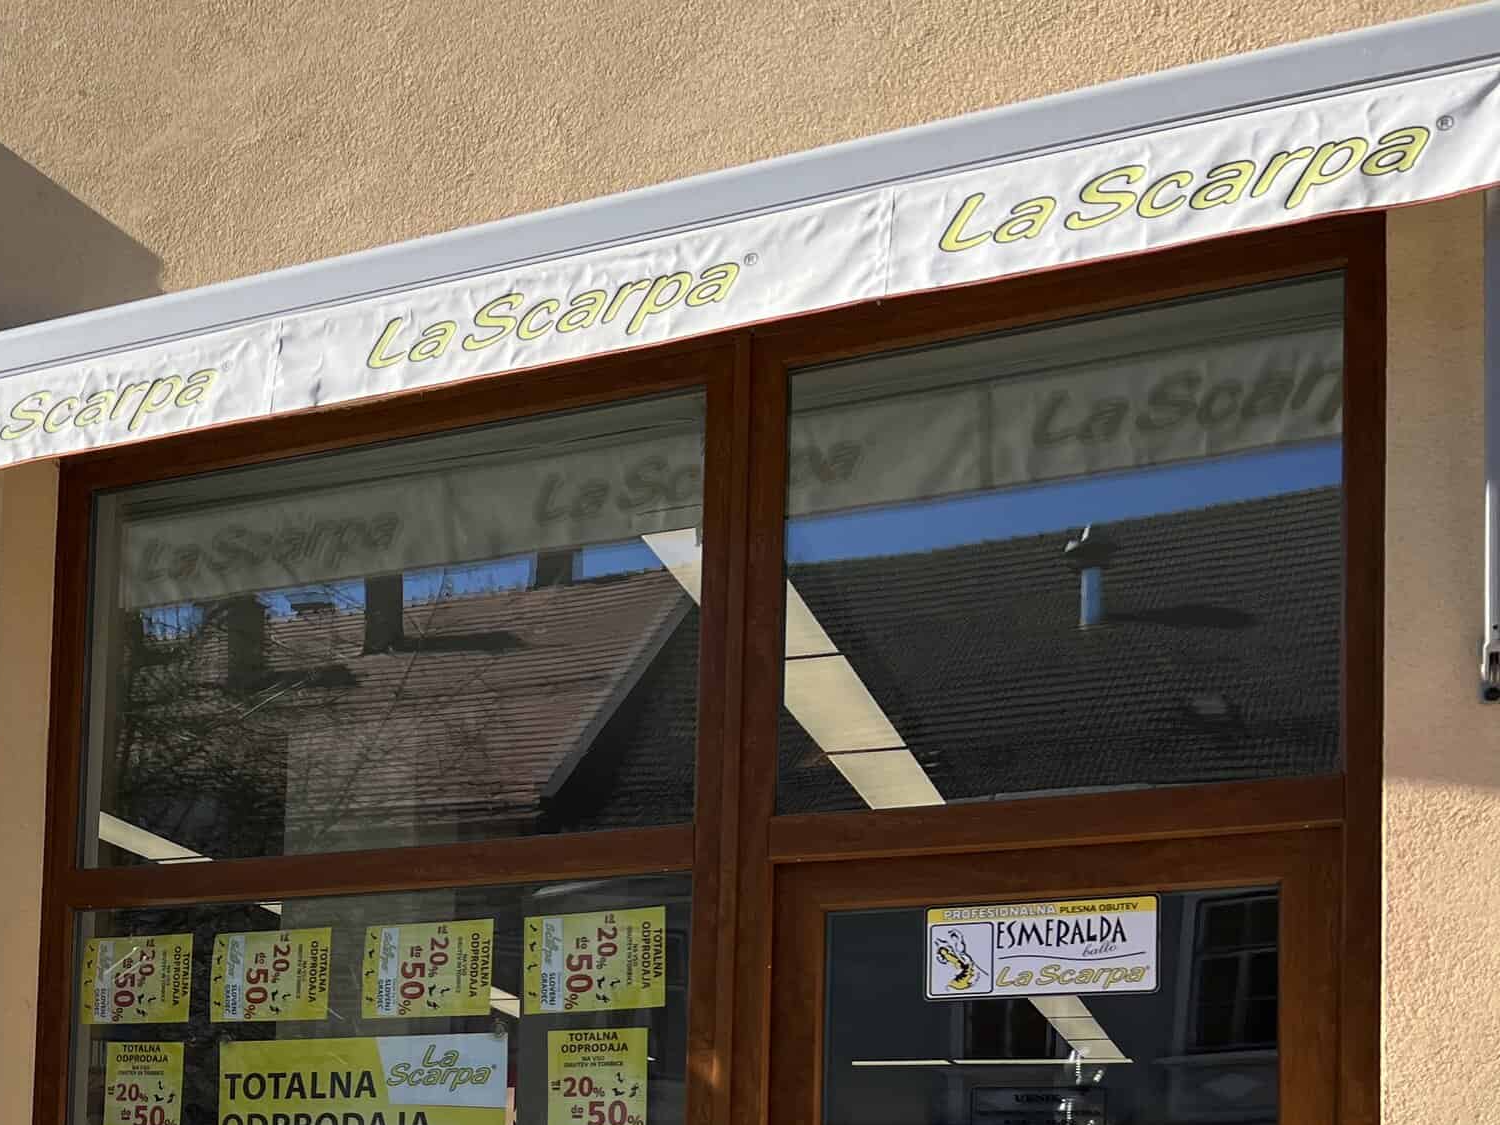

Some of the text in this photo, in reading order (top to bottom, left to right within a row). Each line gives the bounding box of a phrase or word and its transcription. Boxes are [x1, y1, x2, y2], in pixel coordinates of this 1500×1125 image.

[938, 126, 1431, 252] La Scarpa
[367, 263, 740, 369] La Scarpa
[0, 368, 218, 440] Scarpa
[942, 903, 1138, 920] PROFESIONALNA PLESNA OBUTEV
[996, 916, 1126, 949] ESMERALDA
[641, 921, 651, 989] ODPRODAJA
[654, 928, 662, 978] TOTALNA
[565, 953, 594, 1010] 50%
[996, 964, 1146, 989] La Scarpa
[561, 1043, 628, 1053] ODPRODAJA
[569, 1032, 618, 1041] TOTALNA
[422, 1044, 460, 1068] La
[225, 1071, 377, 1100] TOTALNA
[386, 1062, 493, 1092] Scarpa
[563, 1076, 605, 1097] 20%
